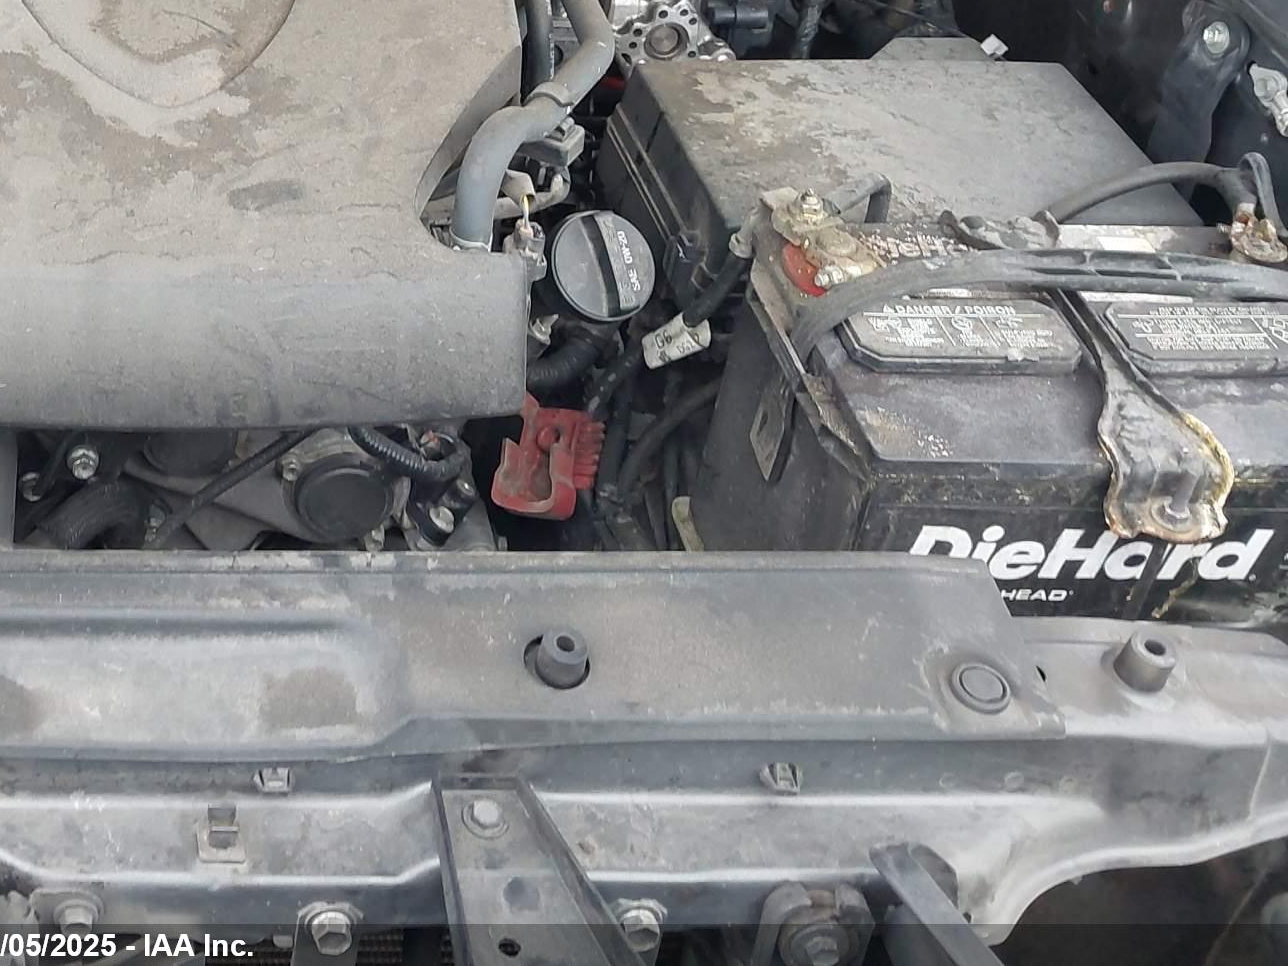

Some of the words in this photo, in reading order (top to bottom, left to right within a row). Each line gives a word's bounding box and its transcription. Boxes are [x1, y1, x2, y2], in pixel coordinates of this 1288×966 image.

[616, 230, 633, 264] 0W-20
[628, 268, 641, 291] SAE
[895, 305, 953, 315] DANGER
[964, 305, 1016, 315] POISON
[910, 525, 1275, 580] DieHard
